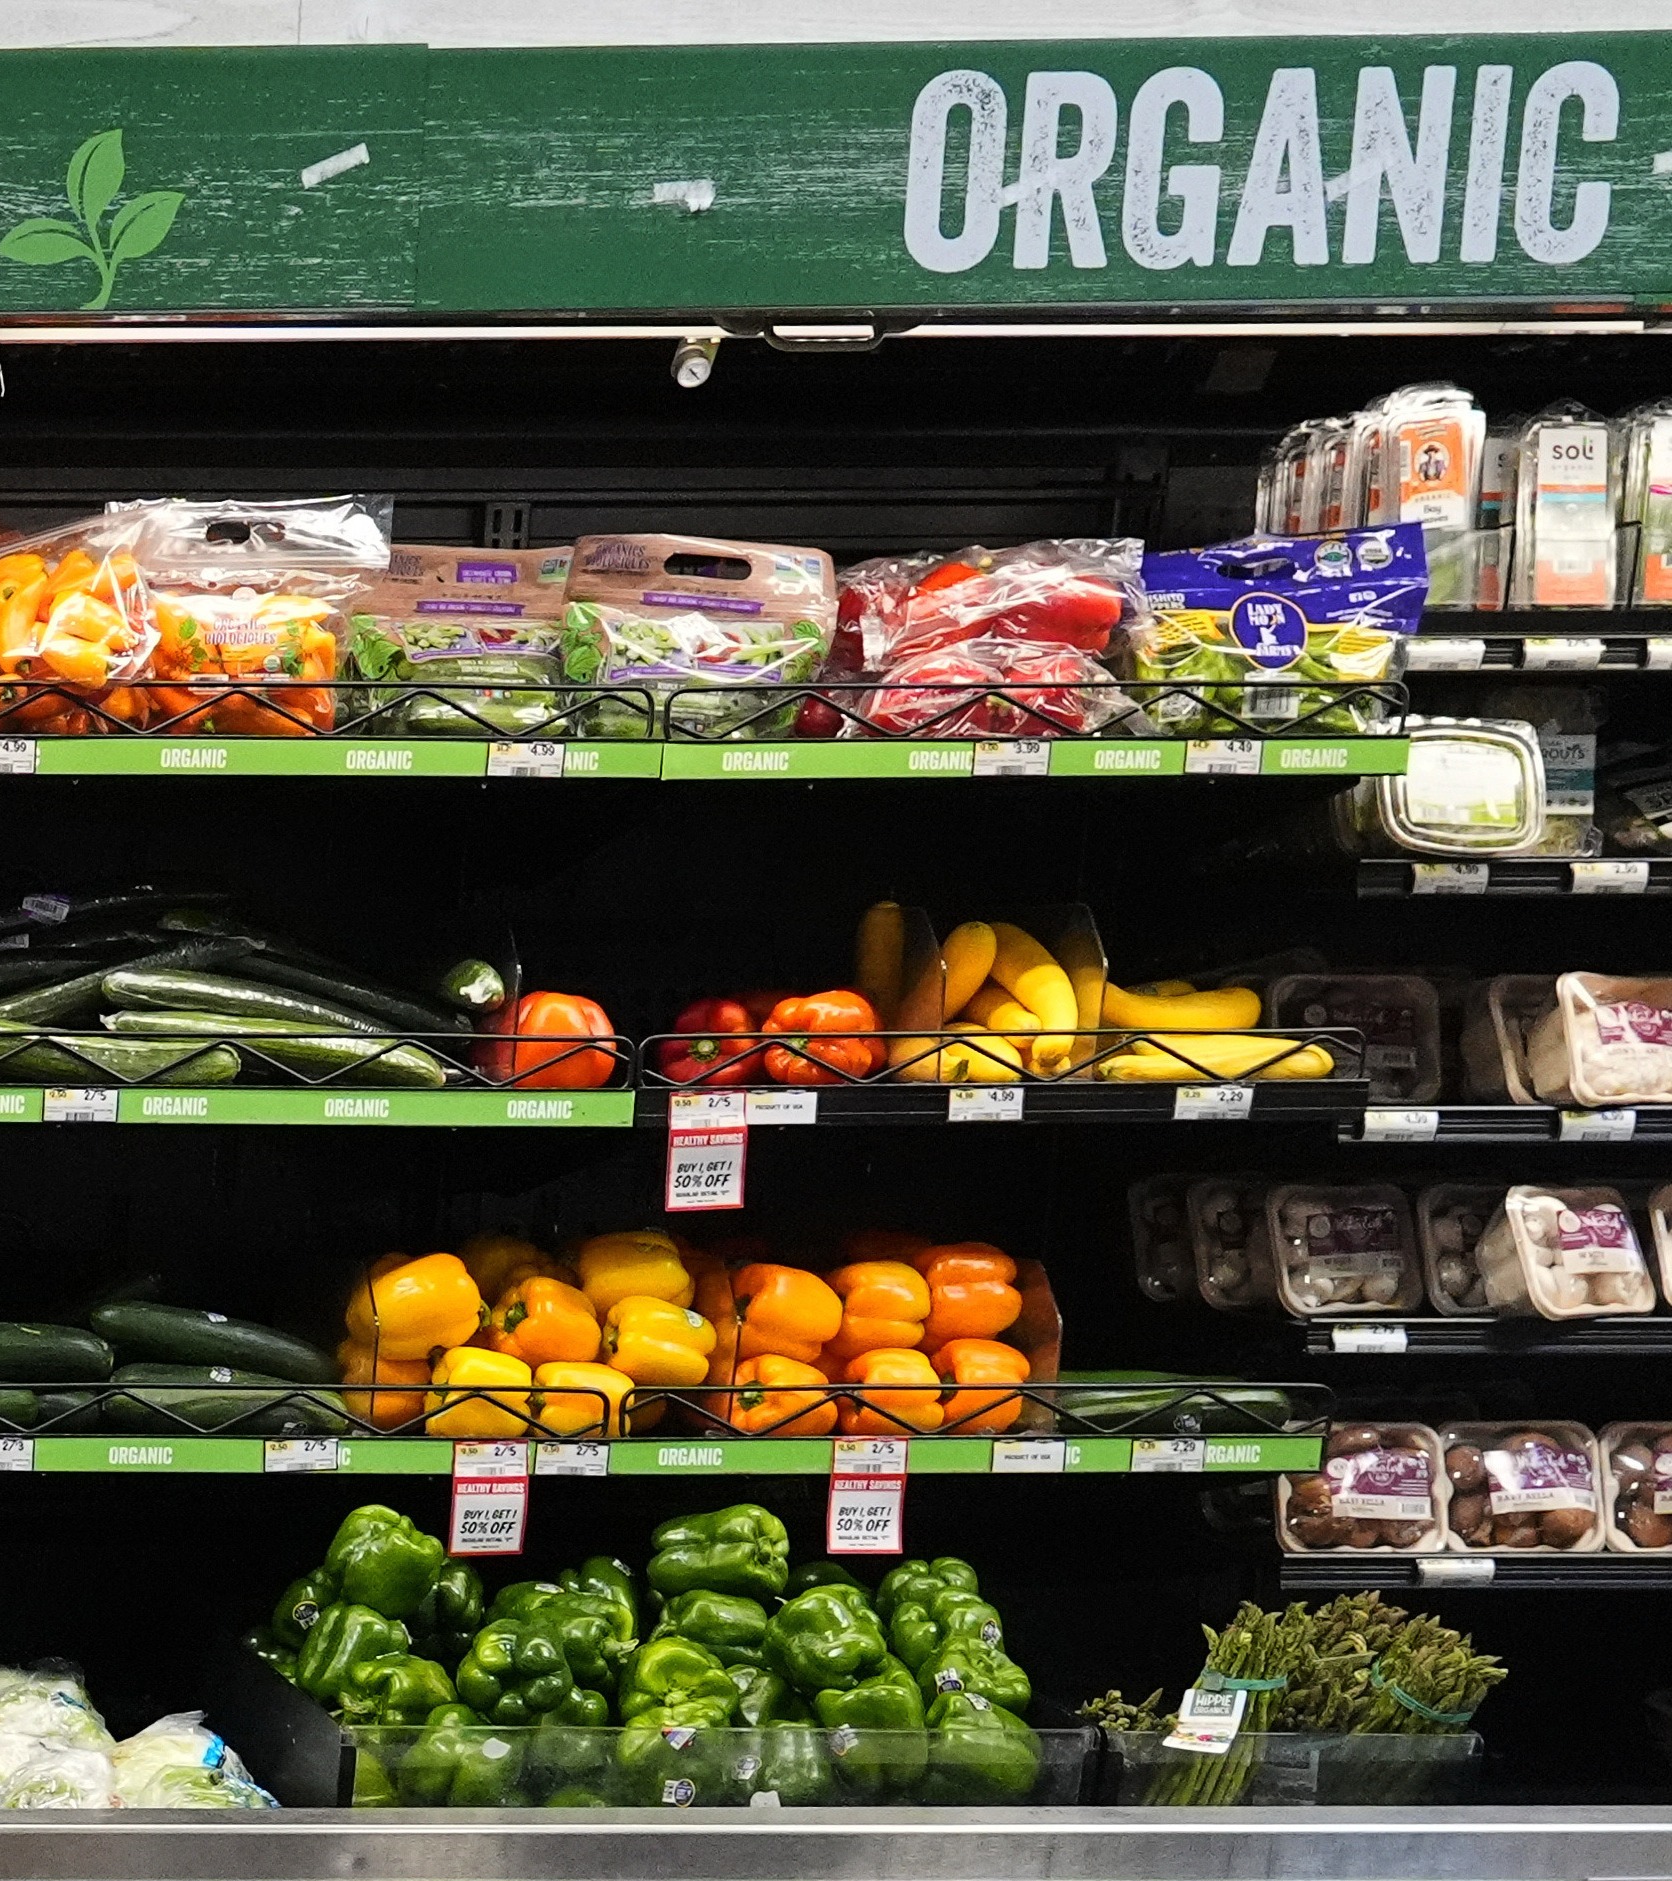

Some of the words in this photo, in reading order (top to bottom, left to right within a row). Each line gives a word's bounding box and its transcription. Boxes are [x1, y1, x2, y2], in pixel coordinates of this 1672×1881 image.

[904, 61, 1621, 272] ORGANIC
[161, 748, 227, 768] ORGANIC
[346, 750, 412, 770] ORGANIC
[564, 751, 599, 770] ANIC
[722, 751, 789, 771] ORGANIC
[1094, 750, 1161, 769] ORGANIC
[1281, 748, 1348, 768] ORGANIC
[142, 1097, 208, 1116] ORGANIC
[324, 1098, 390, 1117] ORGANIC
[507, 1100, 573, 1119] ORGANIC
[674, 1135, 708, 1146] HEALTHY
[710, 1133, 743, 1145] SAVINGS
[677, 1163, 699, 1172] BUY
[707, 1161, 726, 1171] GET
[674, 1175, 702, 1188] 50%
[705, 1174, 731, 1187] OFF
[108, 1446, 173, 1465] ORGANIC
[658, 1447, 723, 1466] ORGANIC
[1206, 1445, 1260, 1464] RGANIC
[457, 1483, 490, 1493] HEALTHY
[492, 1483, 525, 1493] SAVINGS
[835, 1480, 868, 1490] HEALTHY
[868, 1480, 902, 1490] SAVINGS
[464, 1510, 483, 1519] BUY
[492, 1510, 511, 1519] GET
[838, 1507, 858, 1516] BUY
[868, 1507, 886, 1516] GET
[460, 1522, 487, 1534] 50%
[490, 1522, 516, 1534] OFF
[836, 1519, 863, 1531] 50%
[866, 1519, 890, 1532] OFF
